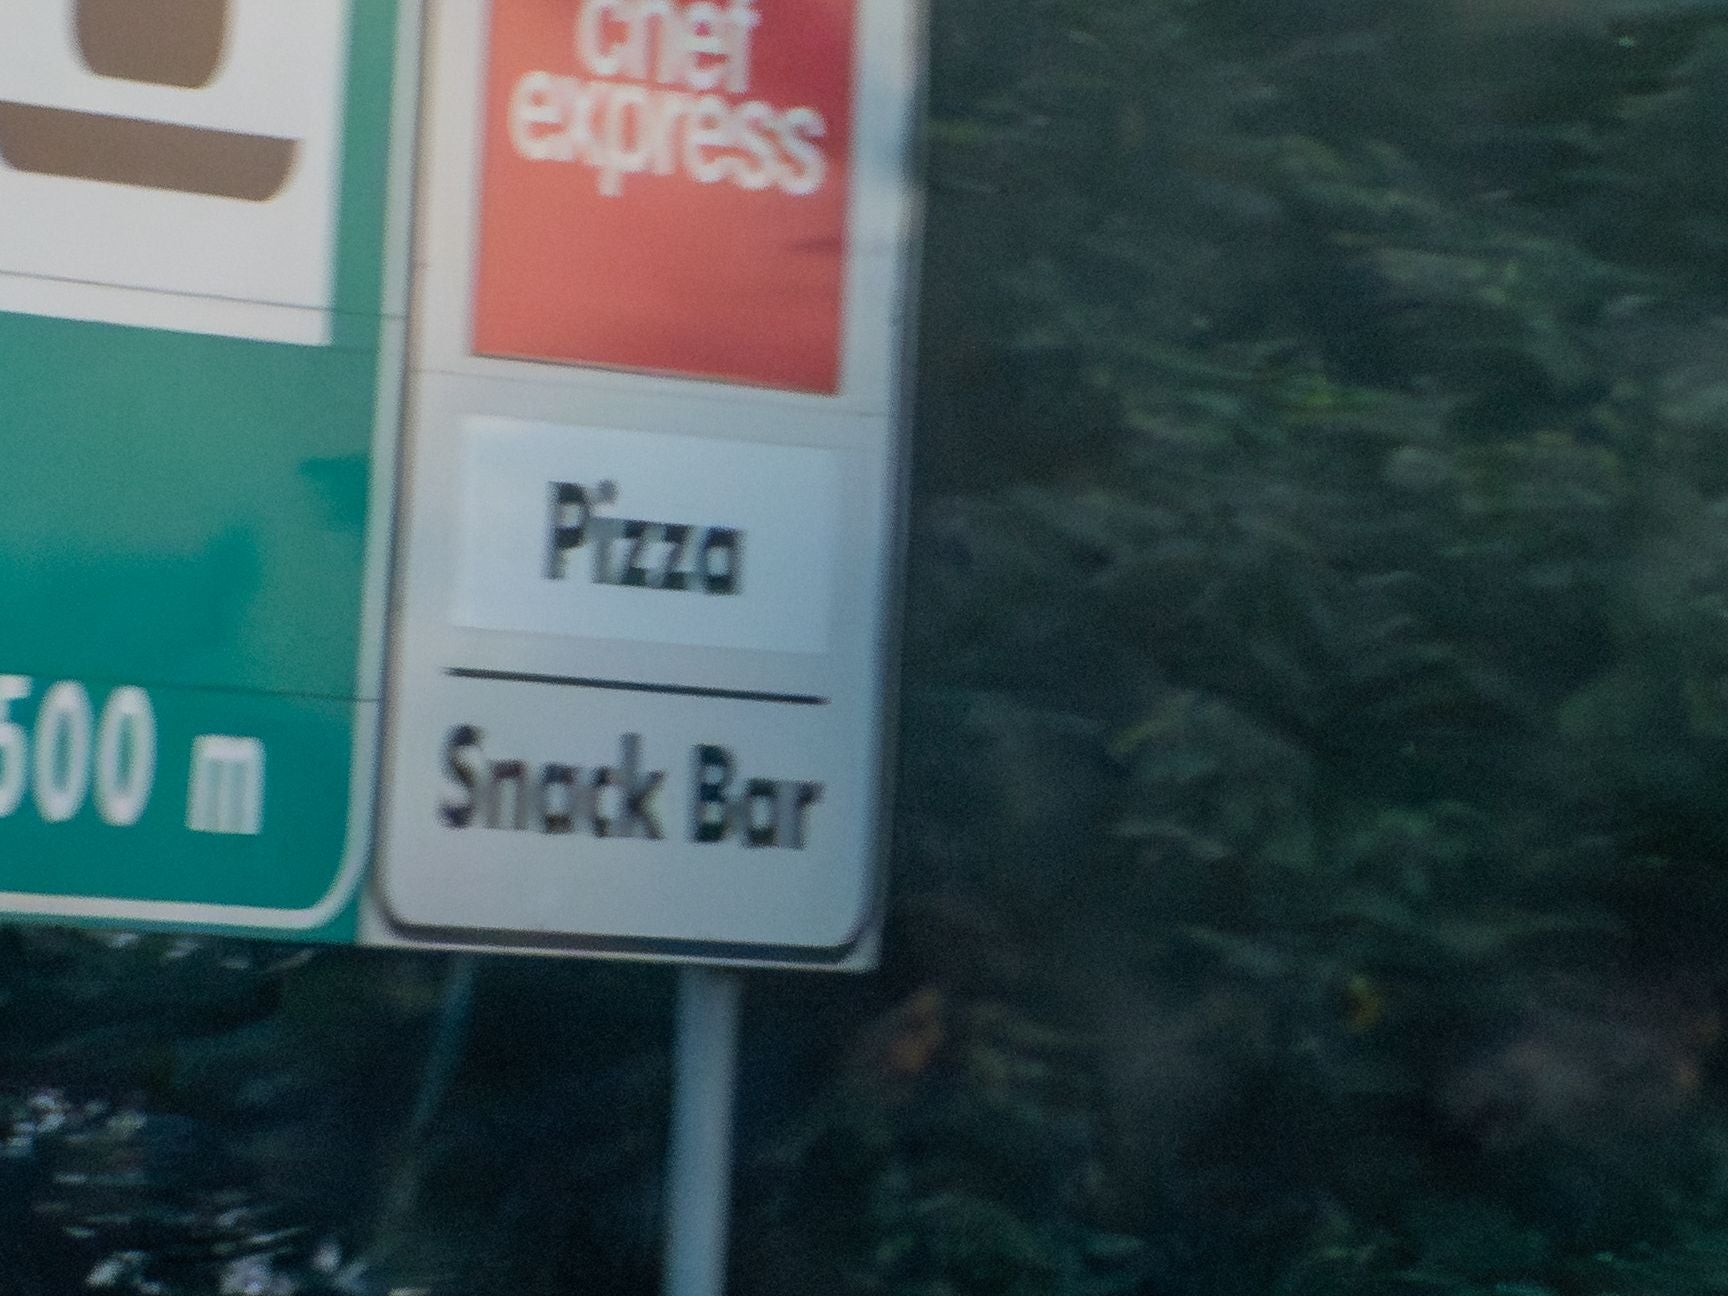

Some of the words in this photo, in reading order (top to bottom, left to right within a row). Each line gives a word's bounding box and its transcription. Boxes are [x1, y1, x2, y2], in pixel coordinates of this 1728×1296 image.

[509, 71, 827, 196] express
[542, 479, 747, 595] Pizza
[185, 735, 266, 835] m
[437, 724, 666, 841] Snack
[689, 743, 827, 849] Bar
